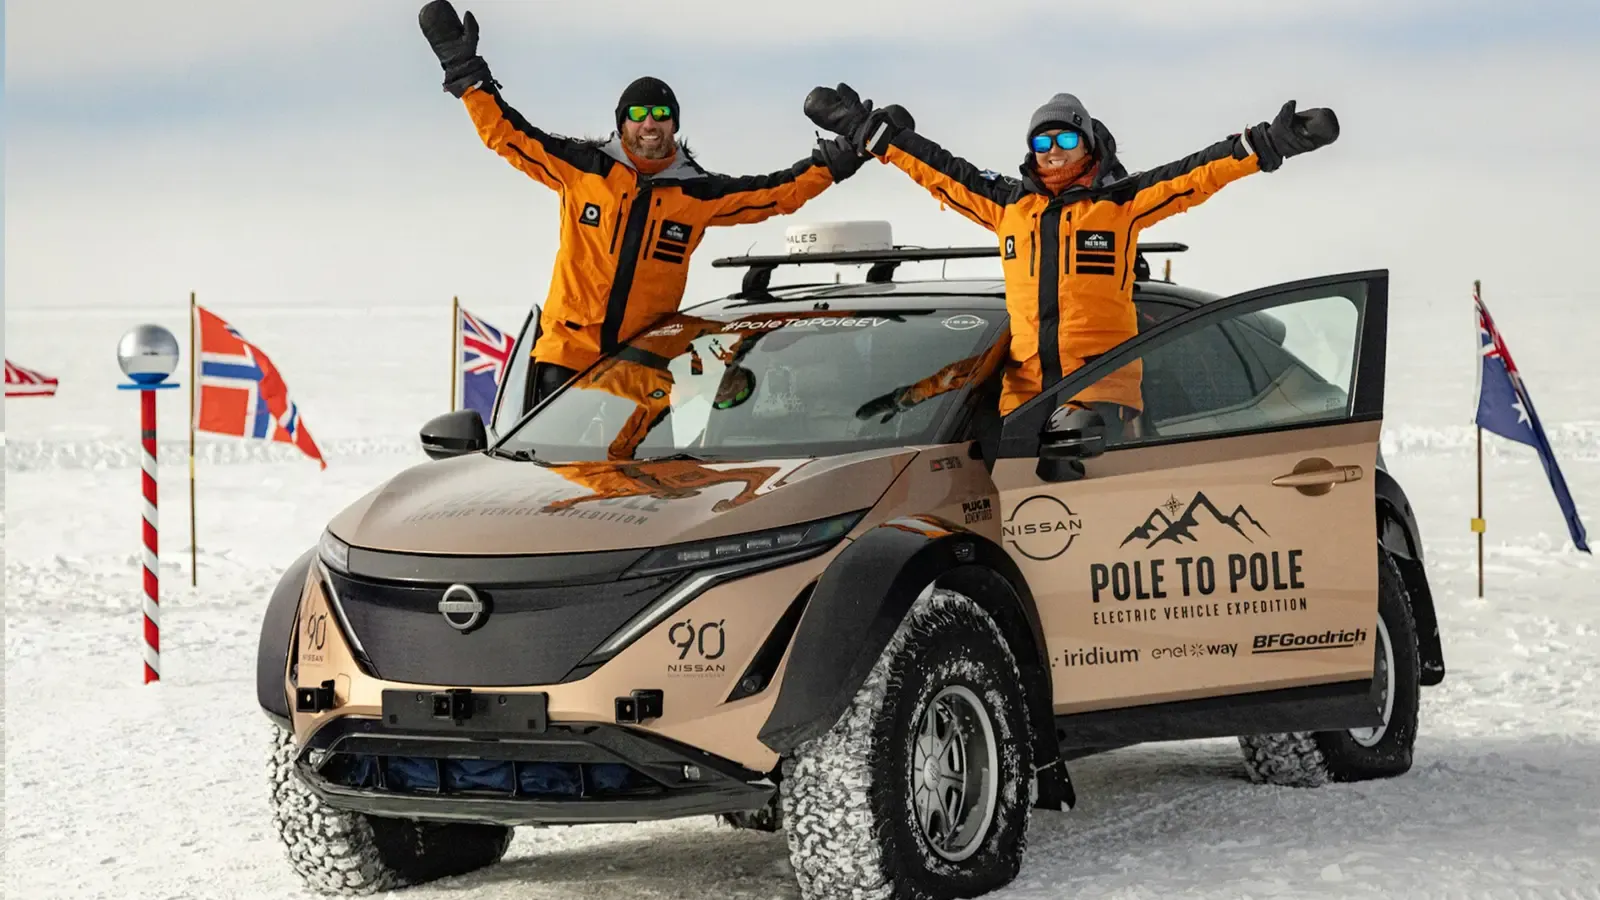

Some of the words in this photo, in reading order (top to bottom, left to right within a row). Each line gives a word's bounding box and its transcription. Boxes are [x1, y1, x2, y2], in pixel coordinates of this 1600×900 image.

[720, 317, 890, 333] #PoleToPoleEV
[962, 499, 983, 514] PLUG
[1002, 519, 1083, 537] NISSAN
[1090, 558, 1167, 603] POLE
[1175, 555, 1216, 597] TO
[1228, 549, 1305, 593] POLE
[1093, 608, 1157, 625] ELECTRIC
[1164, 603, 1220, 620] VEHICLE
[1227, 597, 1308, 616] EXPEDITION
[307, 611, 329, 651] 90
[668, 618, 726, 661] 90
[1252, 628, 1367, 649] BFGoodrich
[1063, 646, 1140, 667] iridium
[1151, 644, 1188, 660] enel
[1206, 642, 1239, 657] way
[667, 664, 726, 672] NISSAN
